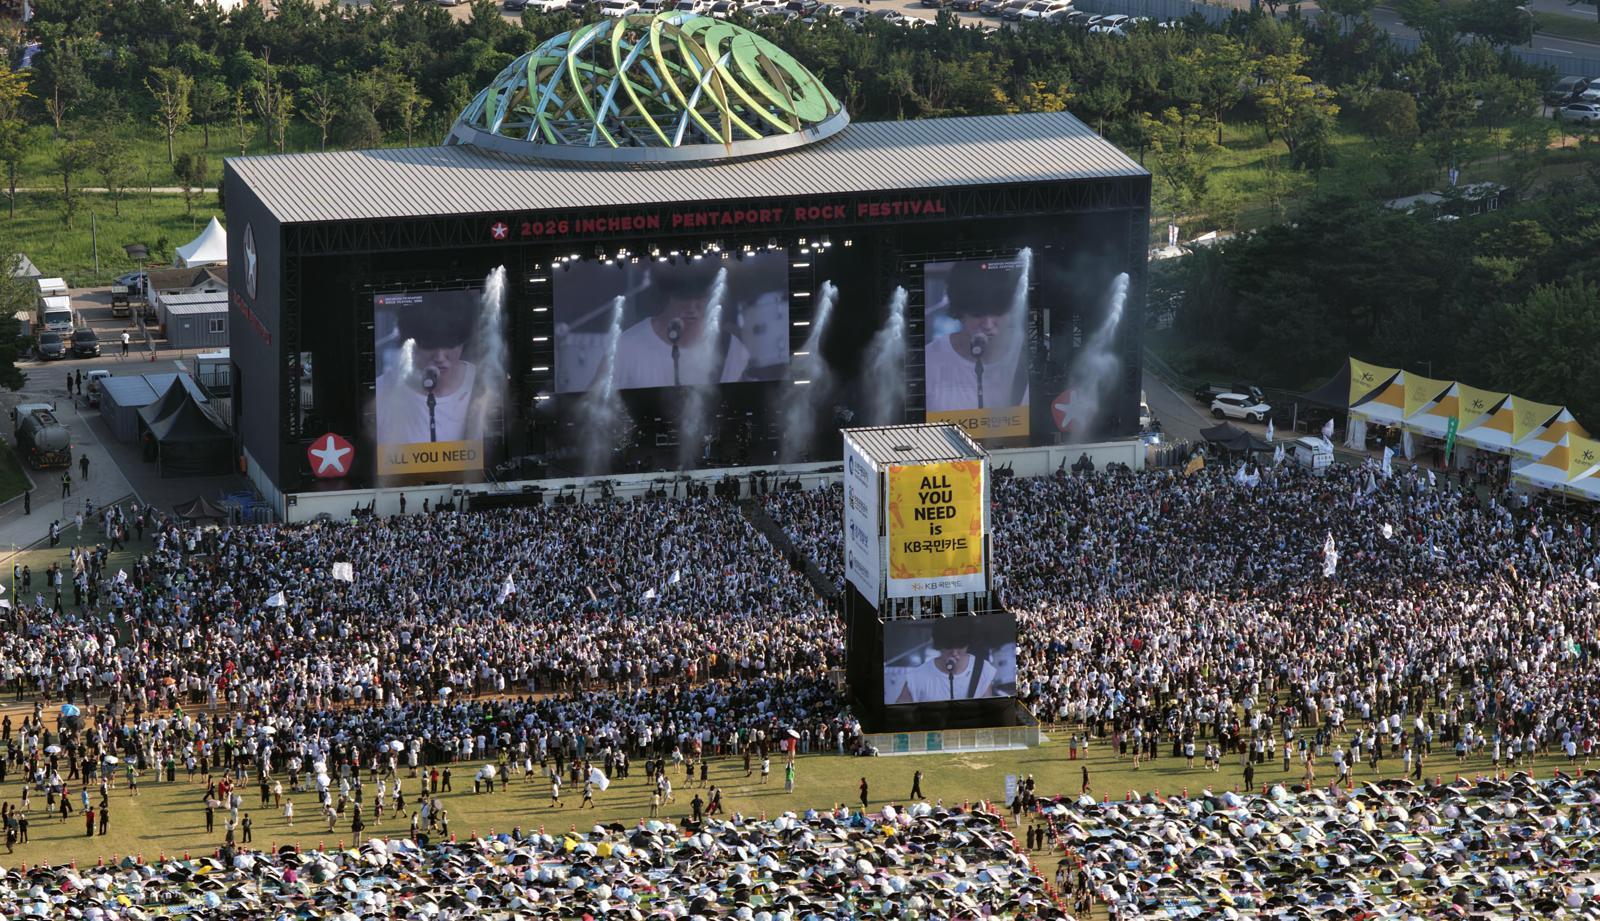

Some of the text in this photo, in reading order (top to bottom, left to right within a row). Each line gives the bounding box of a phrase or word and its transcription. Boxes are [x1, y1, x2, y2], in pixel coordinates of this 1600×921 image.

[521, 199, 945, 236] 2026 INCHEON PENTAPORT ROCK FESTIVAL
[412, 450, 439, 463] YOU
[442, 448, 476, 462] NEED
[920, 475, 951, 489] ALL
[918, 490, 952, 505] YOU
[914, 505, 956, 521] NEED
[929, 522, 942, 536] is
[904, 538, 968, 554] KB국민카드
